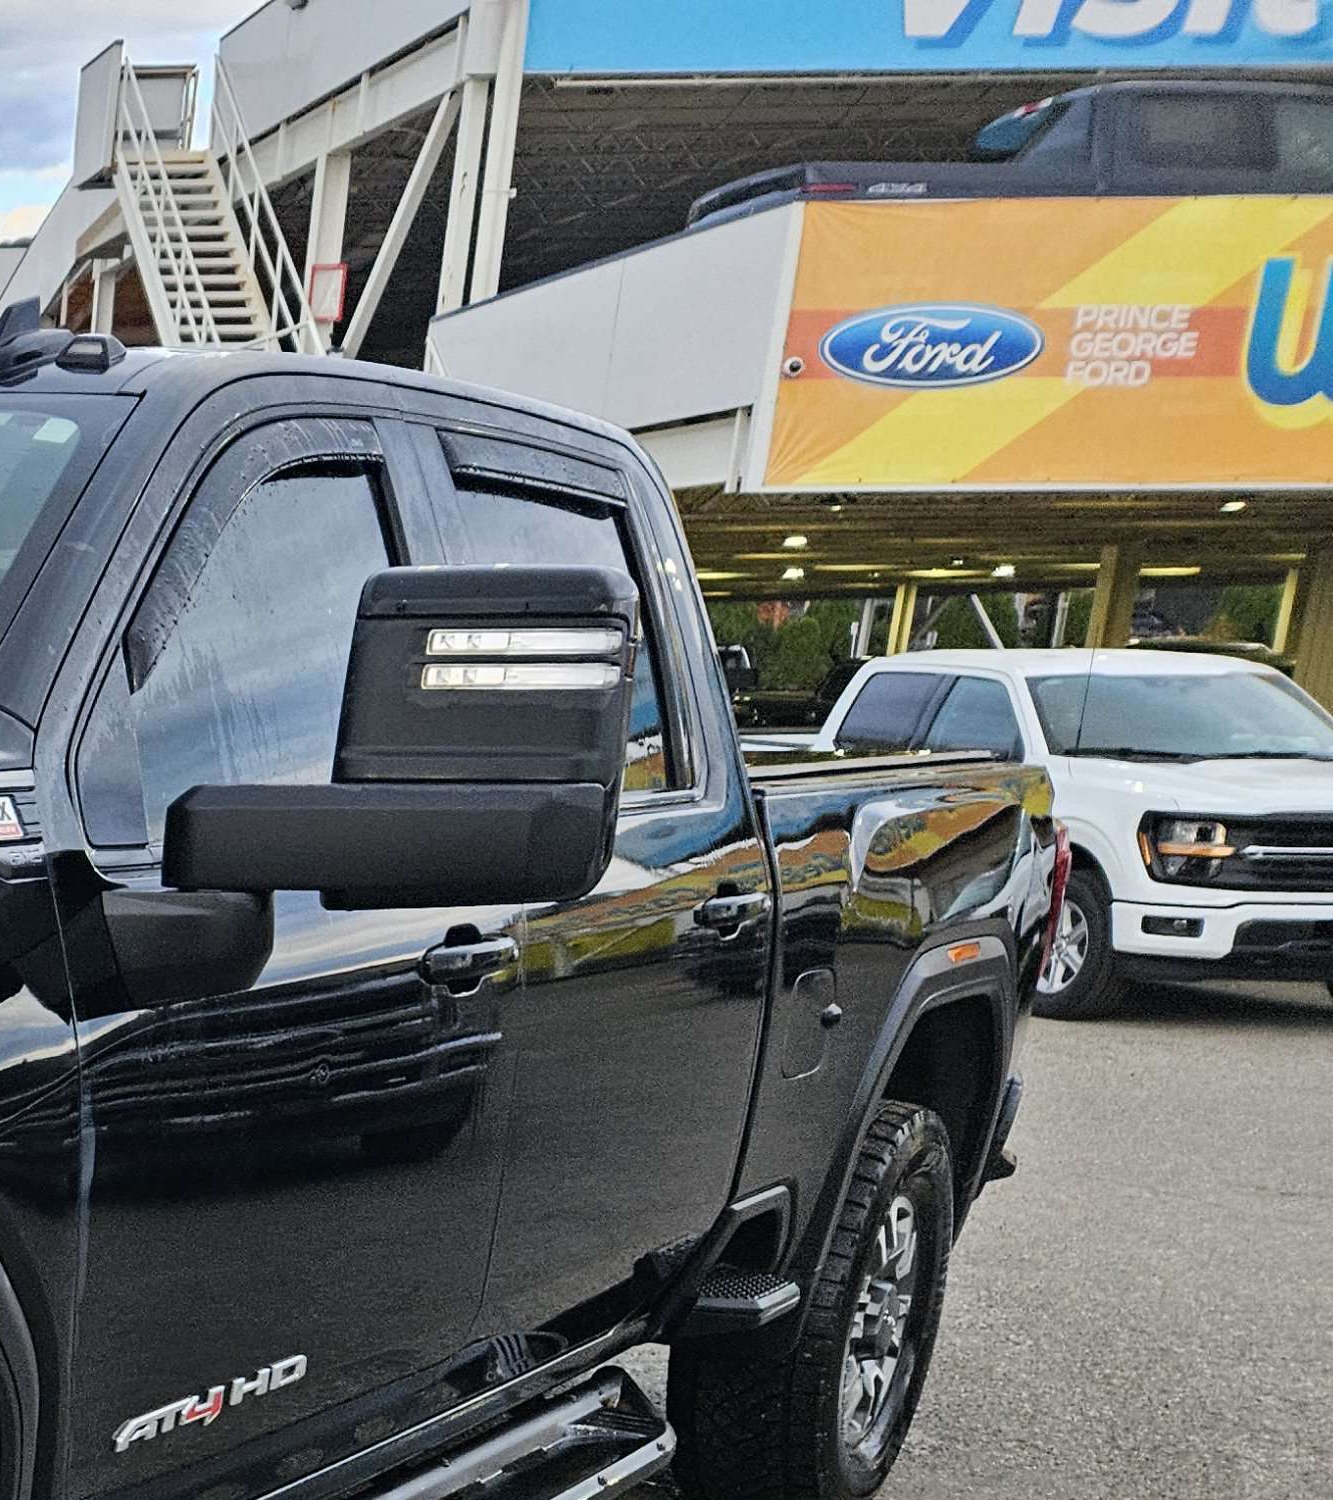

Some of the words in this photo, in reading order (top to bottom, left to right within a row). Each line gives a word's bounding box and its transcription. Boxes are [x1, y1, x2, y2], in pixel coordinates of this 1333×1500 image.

[1075, 303, 1191, 329] PRINCE
[863, 315, 1004, 375] Ford
[1070, 331, 1200, 358] GEORGE
[1066, 360, 1151, 385] FORD
[112, 1384, 226, 1453] AT4
[229, 1353, 308, 1406] HD
